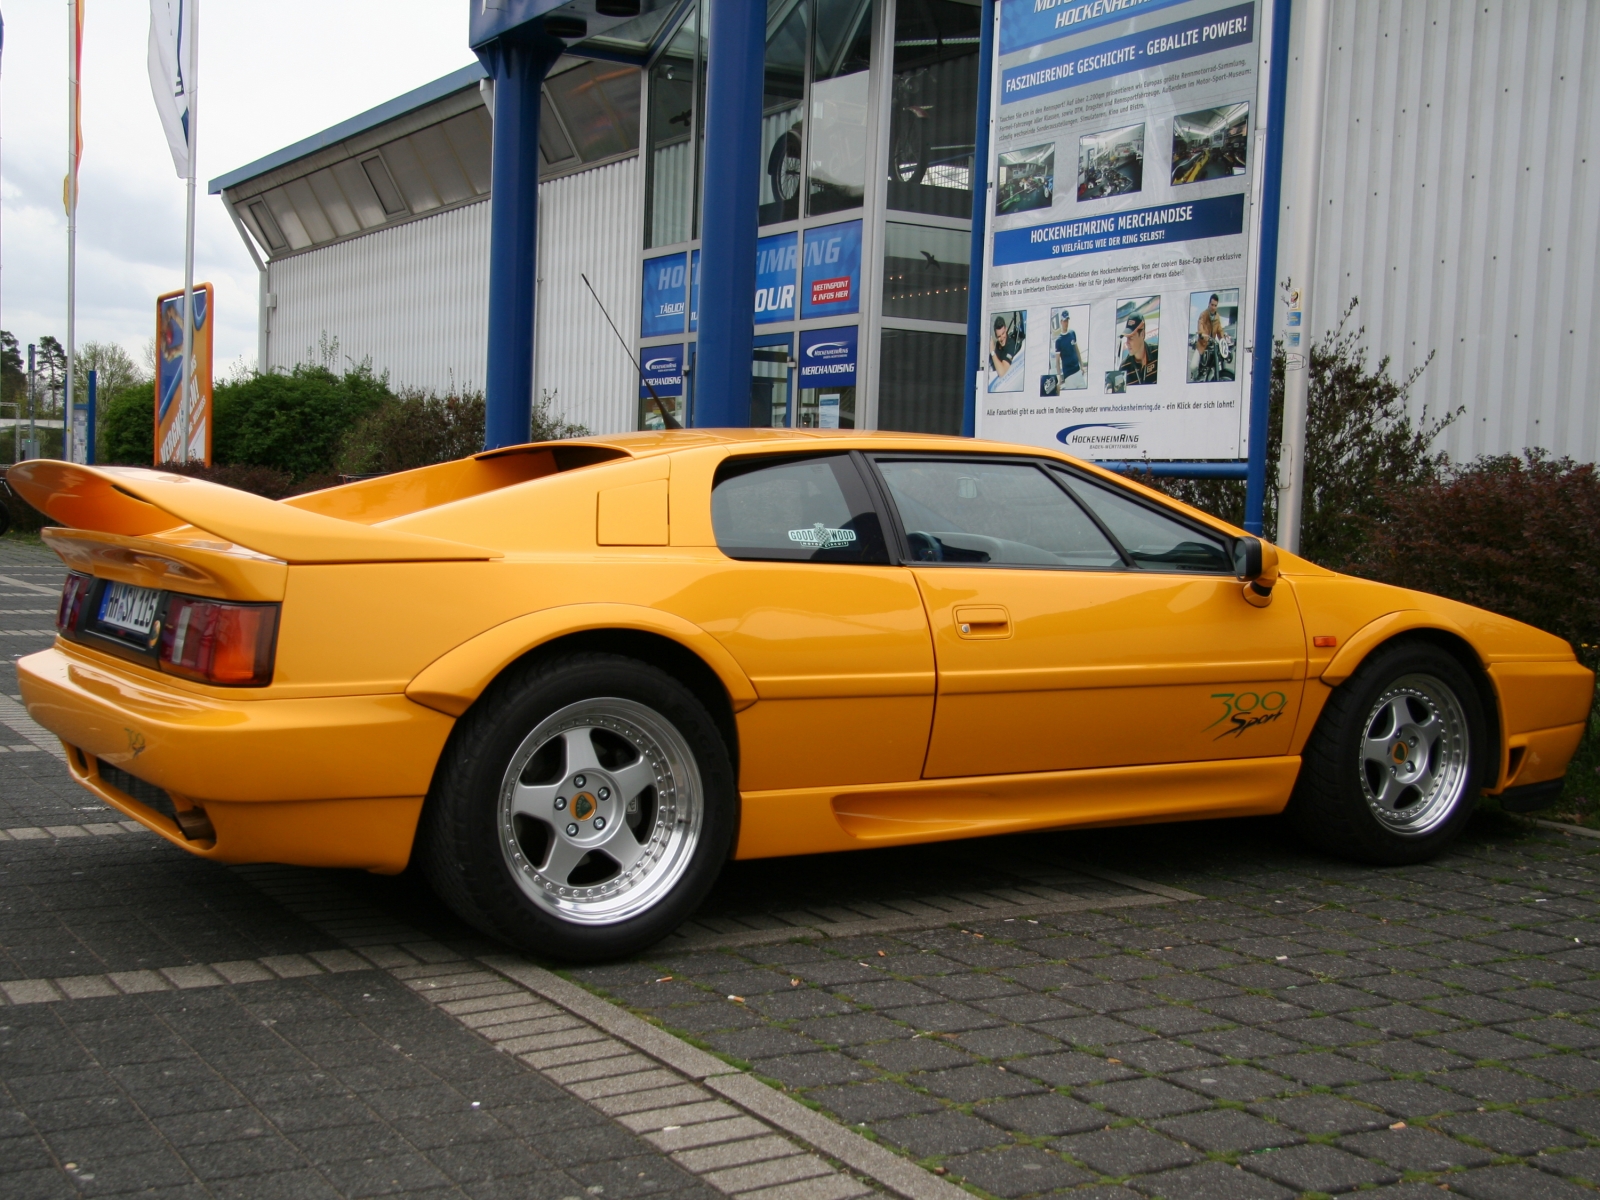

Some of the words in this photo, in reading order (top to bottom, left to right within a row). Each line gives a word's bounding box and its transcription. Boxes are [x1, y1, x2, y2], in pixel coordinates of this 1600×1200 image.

[1006, 62, 1075, 93] FASZINIERENDE
[1077, 45, 1136, 74] GESCHICHTE
[1147, 29, 1199, 55] GEBALLTE
[1202, 15, 1248, 42] POWER!
[1085, 102, 1104, 112] Dragster
[1104, 99, 1113, 107] und
[1162, 83, 1186, 94] Außerdem
[1187, 80, 1195, 88] im
[1196, 69, 1252, 86] Motor-Sport-Museum:
[1105, 85, 1134, 98] präsentieren
[1144, 79, 1162, 89] Europas
[1163, 74, 1180, 85] größte
[1108, 108, 1119, 116] Kino
[1030, 218, 1114, 243] HOCKENHEIMRING
[1117, 206, 1193, 231] MERCHANDISE
[1052, 245, 1060, 255] SO
[1061, 240, 1094, 253] VIELFÄLTIG
[1095, 239, 1107, 249] WIE
[1108, 237, 1120, 246] DER
[1121, 235, 1138, 245] RING
[1139, 230, 1165, 243] SELBST!
[1000, 280, 1009, 289] gibt
[1161, 259, 1177, 267] coolen
[1179, 257, 1201, 266] Base-Cap
[1216, 252, 1242, 261] exklusive
[1078, 279, 1087, 287] hier
[1102, 278, 1116, 286] jeden
[1116, 274, 1152, 284] Motorsport-Fan
[1153, 271, 1167, 279] etwas
[813, 280, 849, 292] MEETINGPOINT
[818, 292, 834, 300] INFOS
[835, 290, 849, 298] HIER
[660, 302, 684, 314] TÄGLICH
[801, 363, 855, 376] MERCHANDISING
[996, 408, 1018, 416] Fanartikel
[1019, 408, 1029, 416] gibt
[1055, 405, 1084, 414] Online-Shop
[1099, 404, 1161, 412] www.hockenheimring.de
[1203, 401, 1215, 409] sich
[1216, 400, 1235, 408] lohnt!
[1071, 433, 1139, 443] HOCKENHEIMRING
[790, 530, 814, 541] GOOD
[829, 529, 854, 541] WOOD
[134, 590, 160, 628] 115
[1201, 691, 1286, 733] 300
[1213, 700, 1288, 742] Sport
